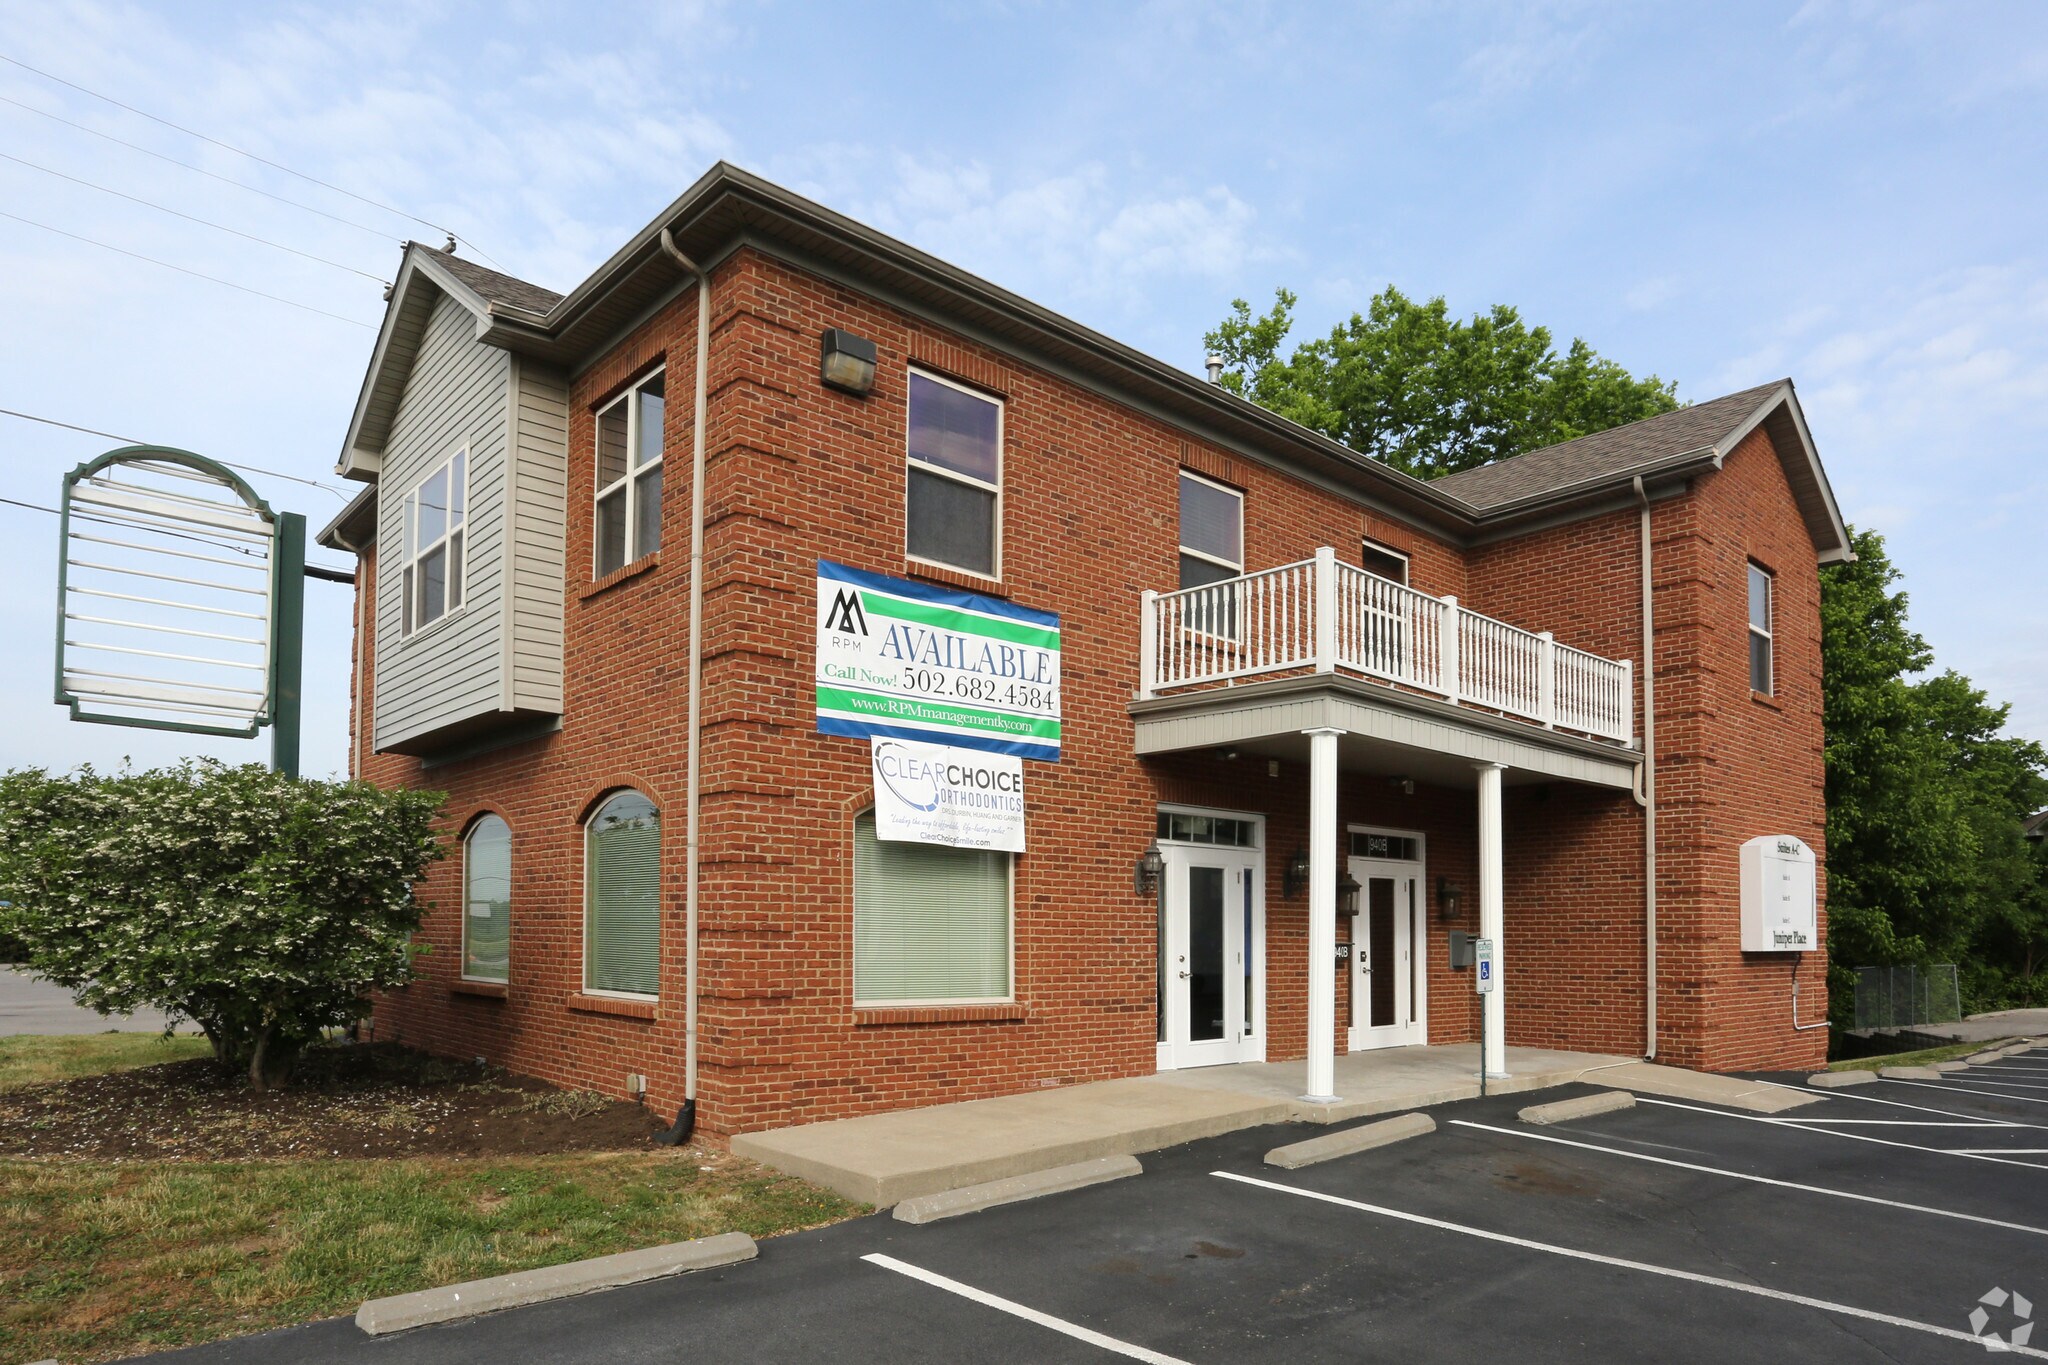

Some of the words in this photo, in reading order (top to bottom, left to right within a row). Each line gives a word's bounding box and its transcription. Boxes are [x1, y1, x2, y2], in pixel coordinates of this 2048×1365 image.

[832, 636, 862, 652] RPM
[879, 623, 1053, 685] AVAILABLE
[824, 663, 856, 680] Call
[860, 670, 898, 687] Now!
[903, 667, 1055, 711] 502.682.4584
[851, 698, 1033, 733] www.RPMmanagementky.com
[940, 788, 1022, 813] ORTHODONTICS
[919, 831, 991, 847] ClearChoiceSmile.com
[1793, 931, 1806, 944] Place
